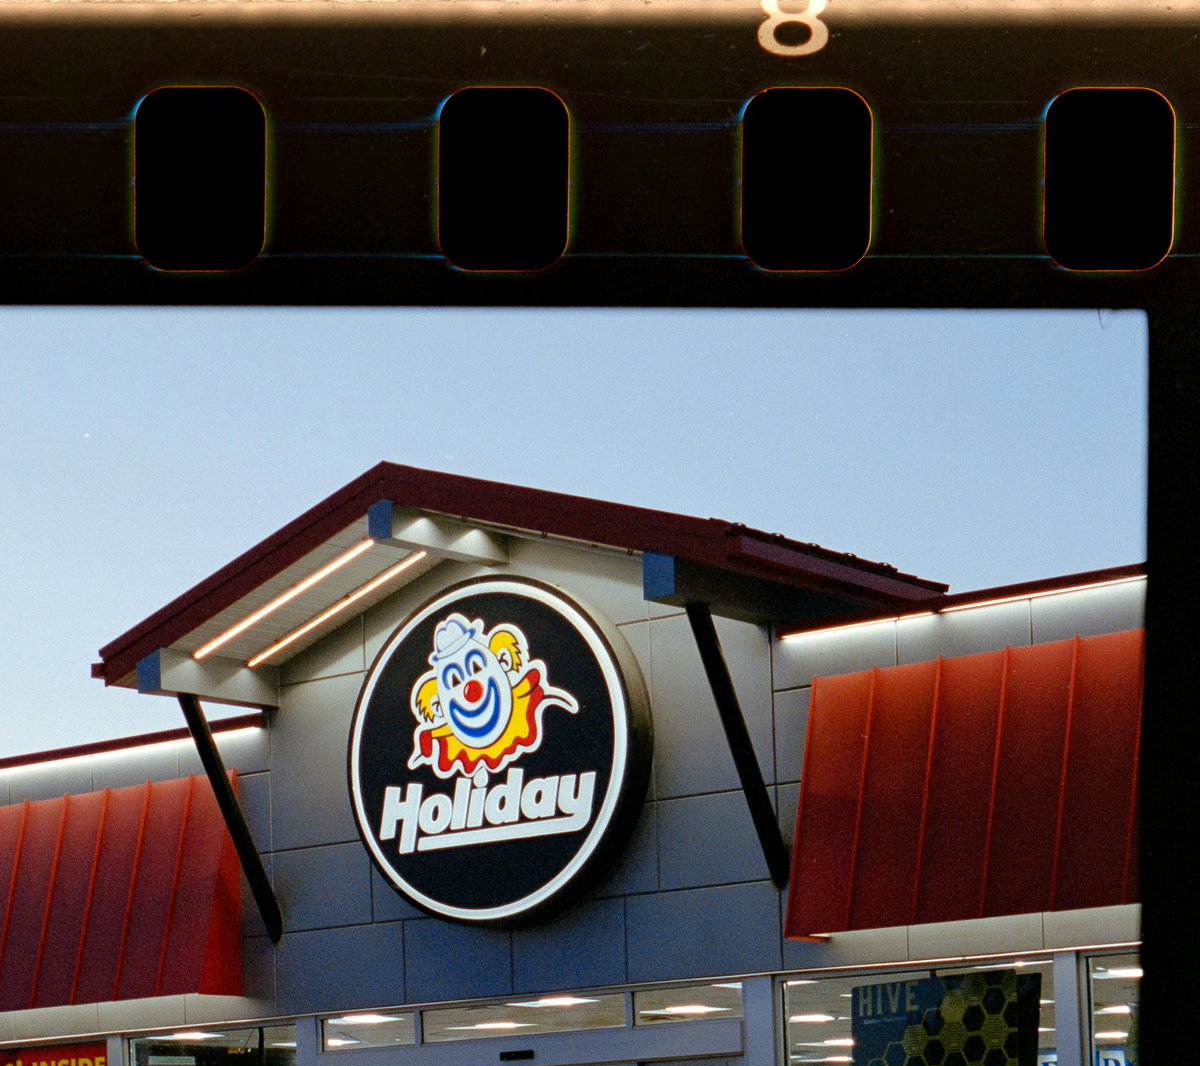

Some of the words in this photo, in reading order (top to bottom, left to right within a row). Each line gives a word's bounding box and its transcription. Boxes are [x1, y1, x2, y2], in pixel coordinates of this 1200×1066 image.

[757, 0, 829, 56] 8
[380, 767, 596, 854] Holiday
[860, 981, 919, 1017] HIVE
